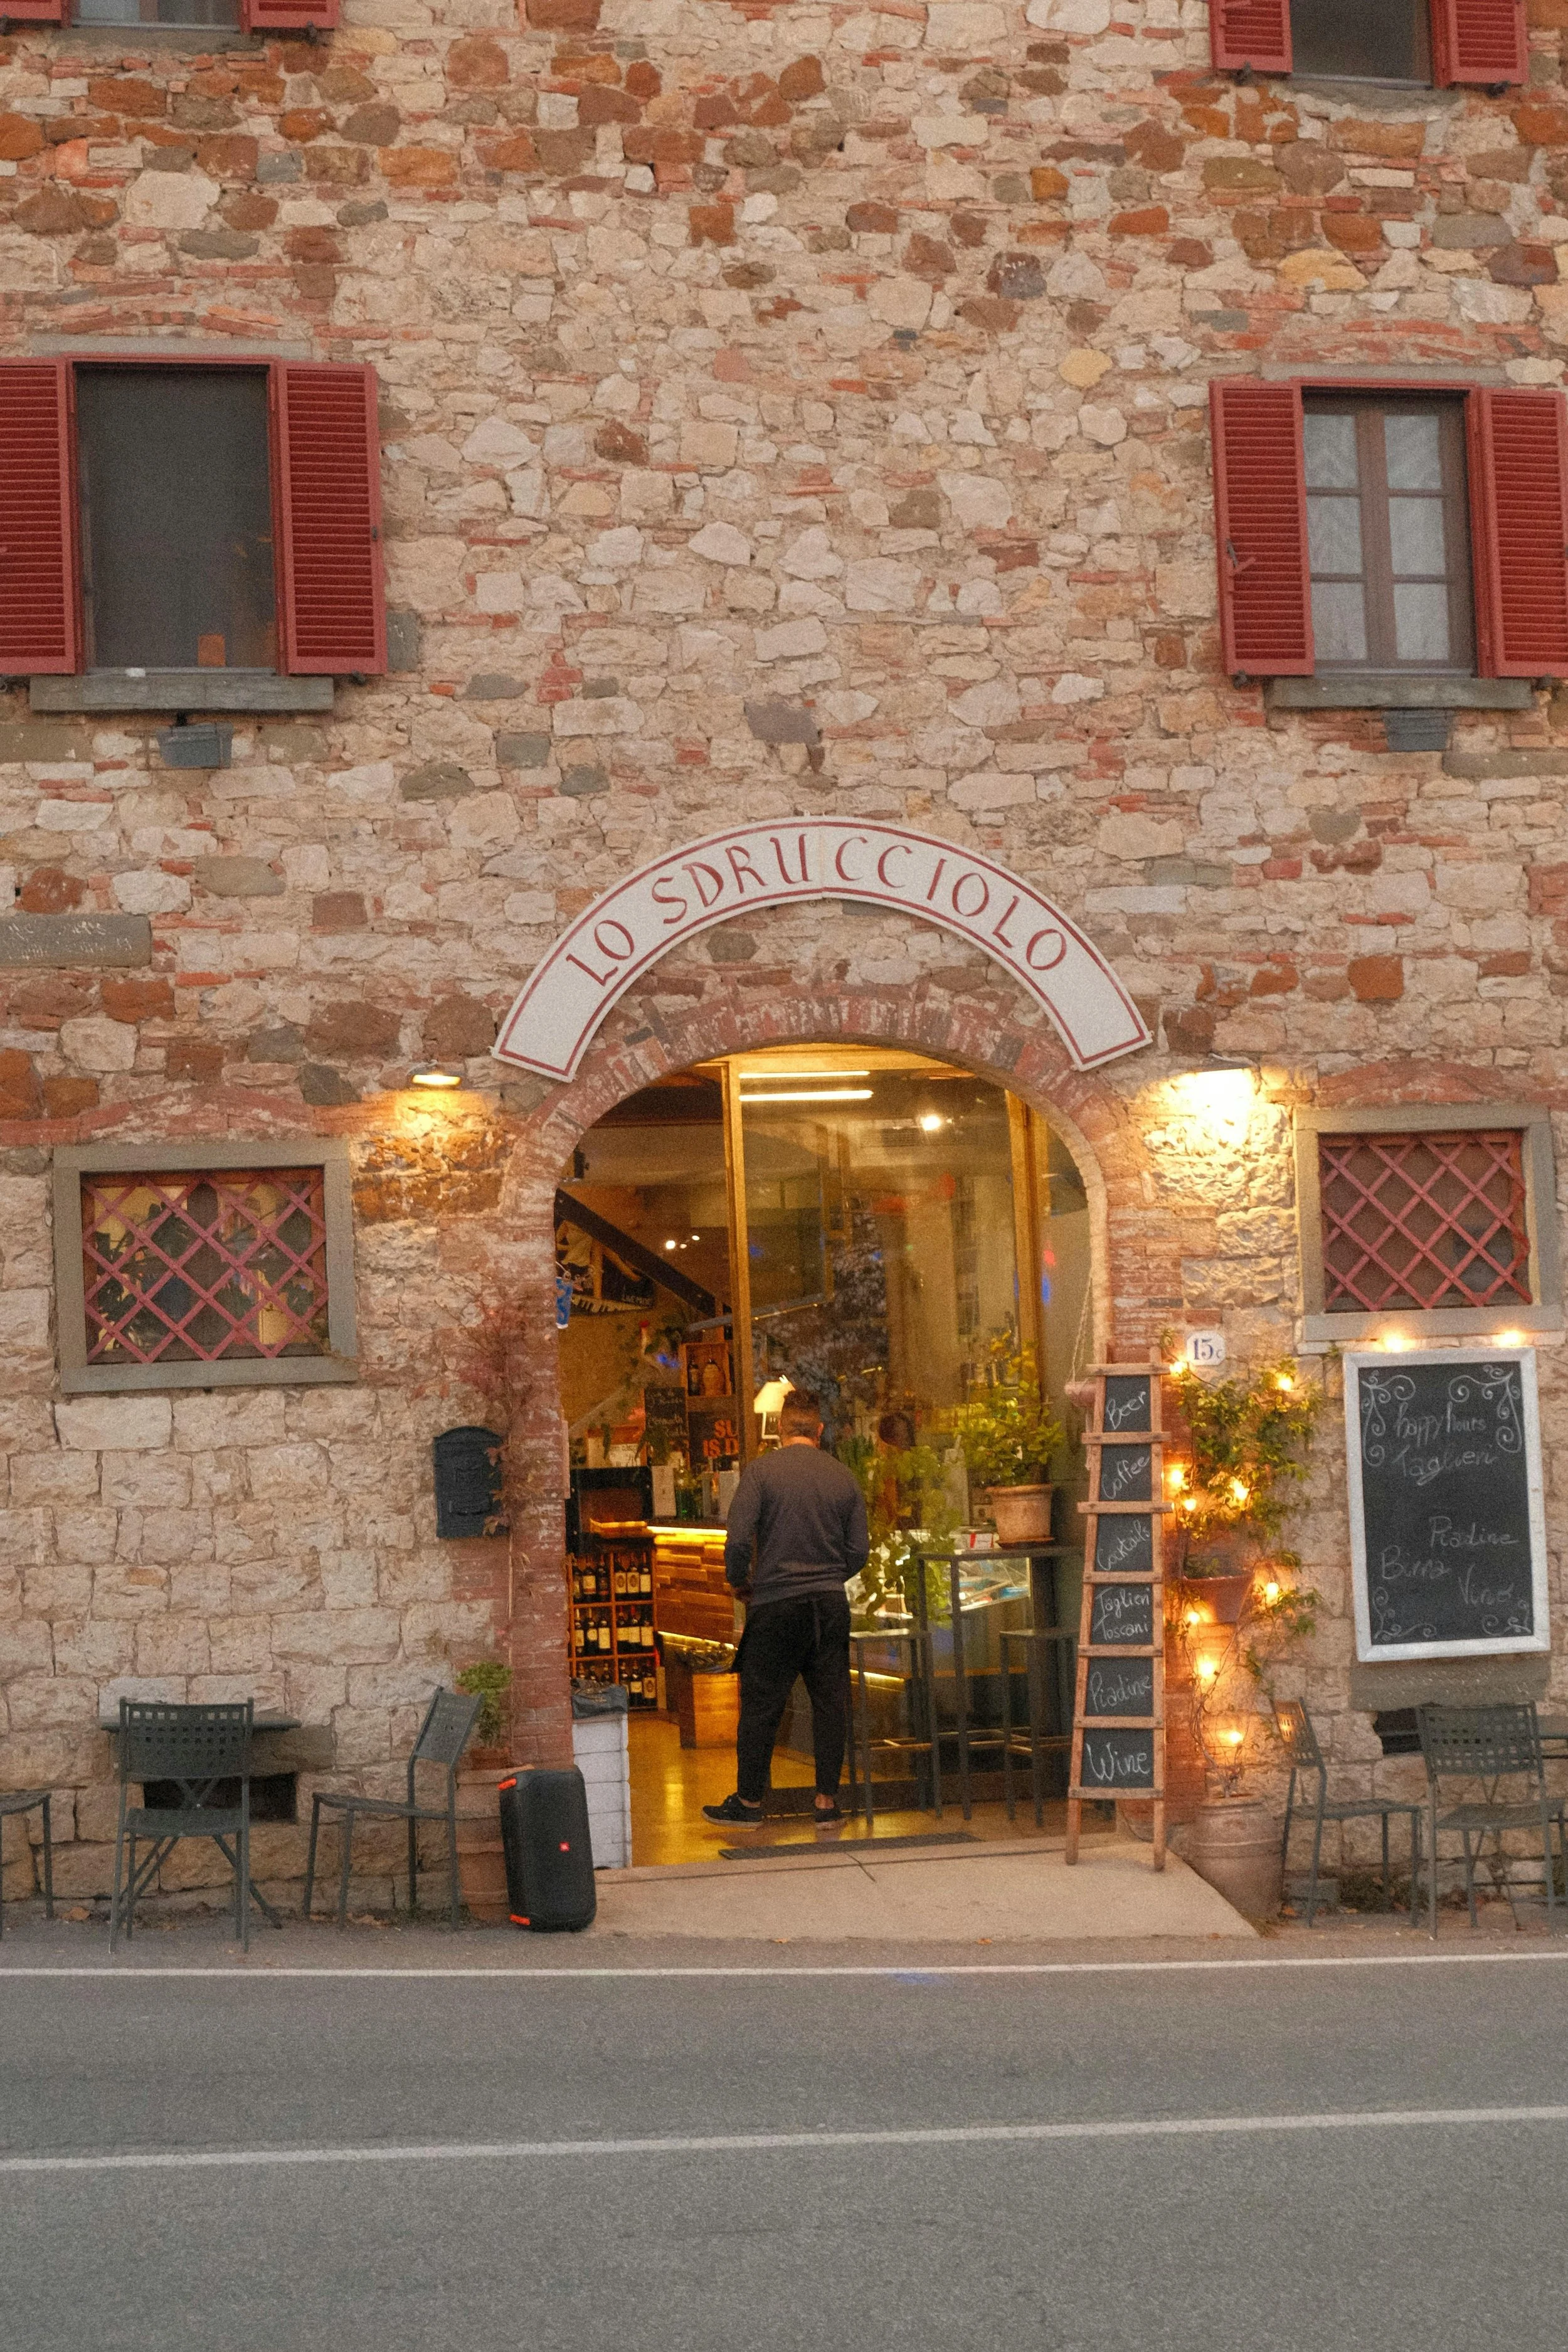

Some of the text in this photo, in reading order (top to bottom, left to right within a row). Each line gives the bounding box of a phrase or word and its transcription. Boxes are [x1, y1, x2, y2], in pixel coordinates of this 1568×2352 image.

[566, 833, 1066, 987] LO SDRUCCIOLO
[1107, 1391, 1147, 1430] Beer
[1102, 1455, 1150, 1500] Coffee
[1097, 1519, 1150, 1571] Cocktails
[1093, 1613, 1149, 1641] Toscani
[1088, 1671, 1152, 1712] Piadine
[1086, 1742, 1151, 1781] Wine
